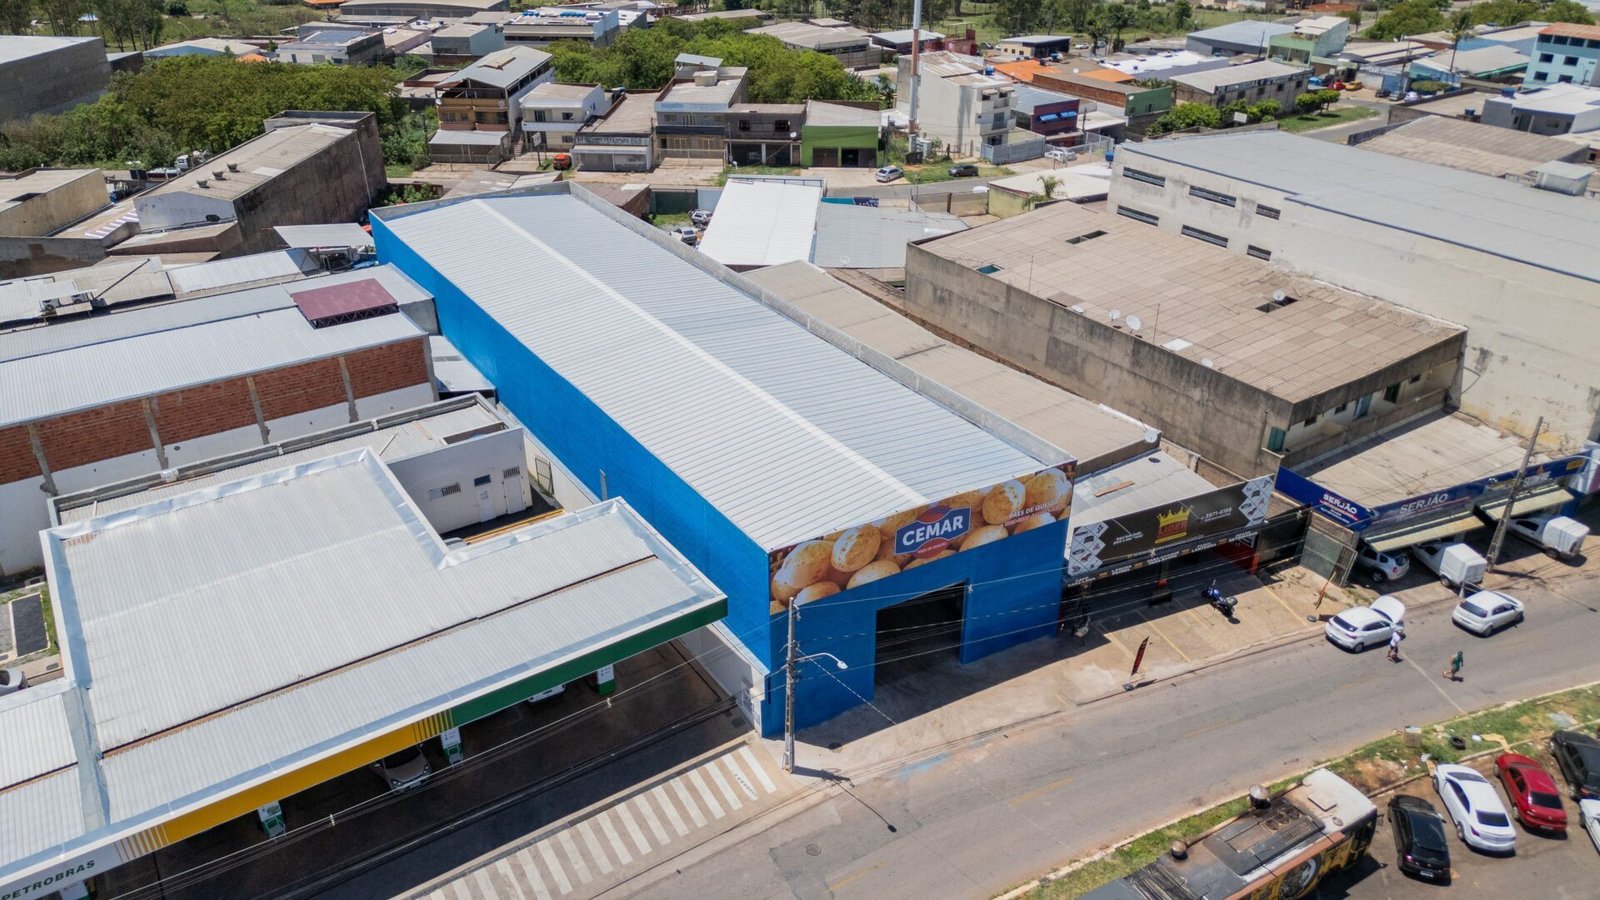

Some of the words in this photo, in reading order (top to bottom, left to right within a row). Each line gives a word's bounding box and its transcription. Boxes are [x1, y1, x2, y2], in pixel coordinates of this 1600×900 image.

[1323, 493, 1357, 514] SERJÃO
[1400, 493, 1448, 513] SERJÃO
[902, 515, 963, 546] CEMAR
[1, 859, 96, 900] PETROBRAS
